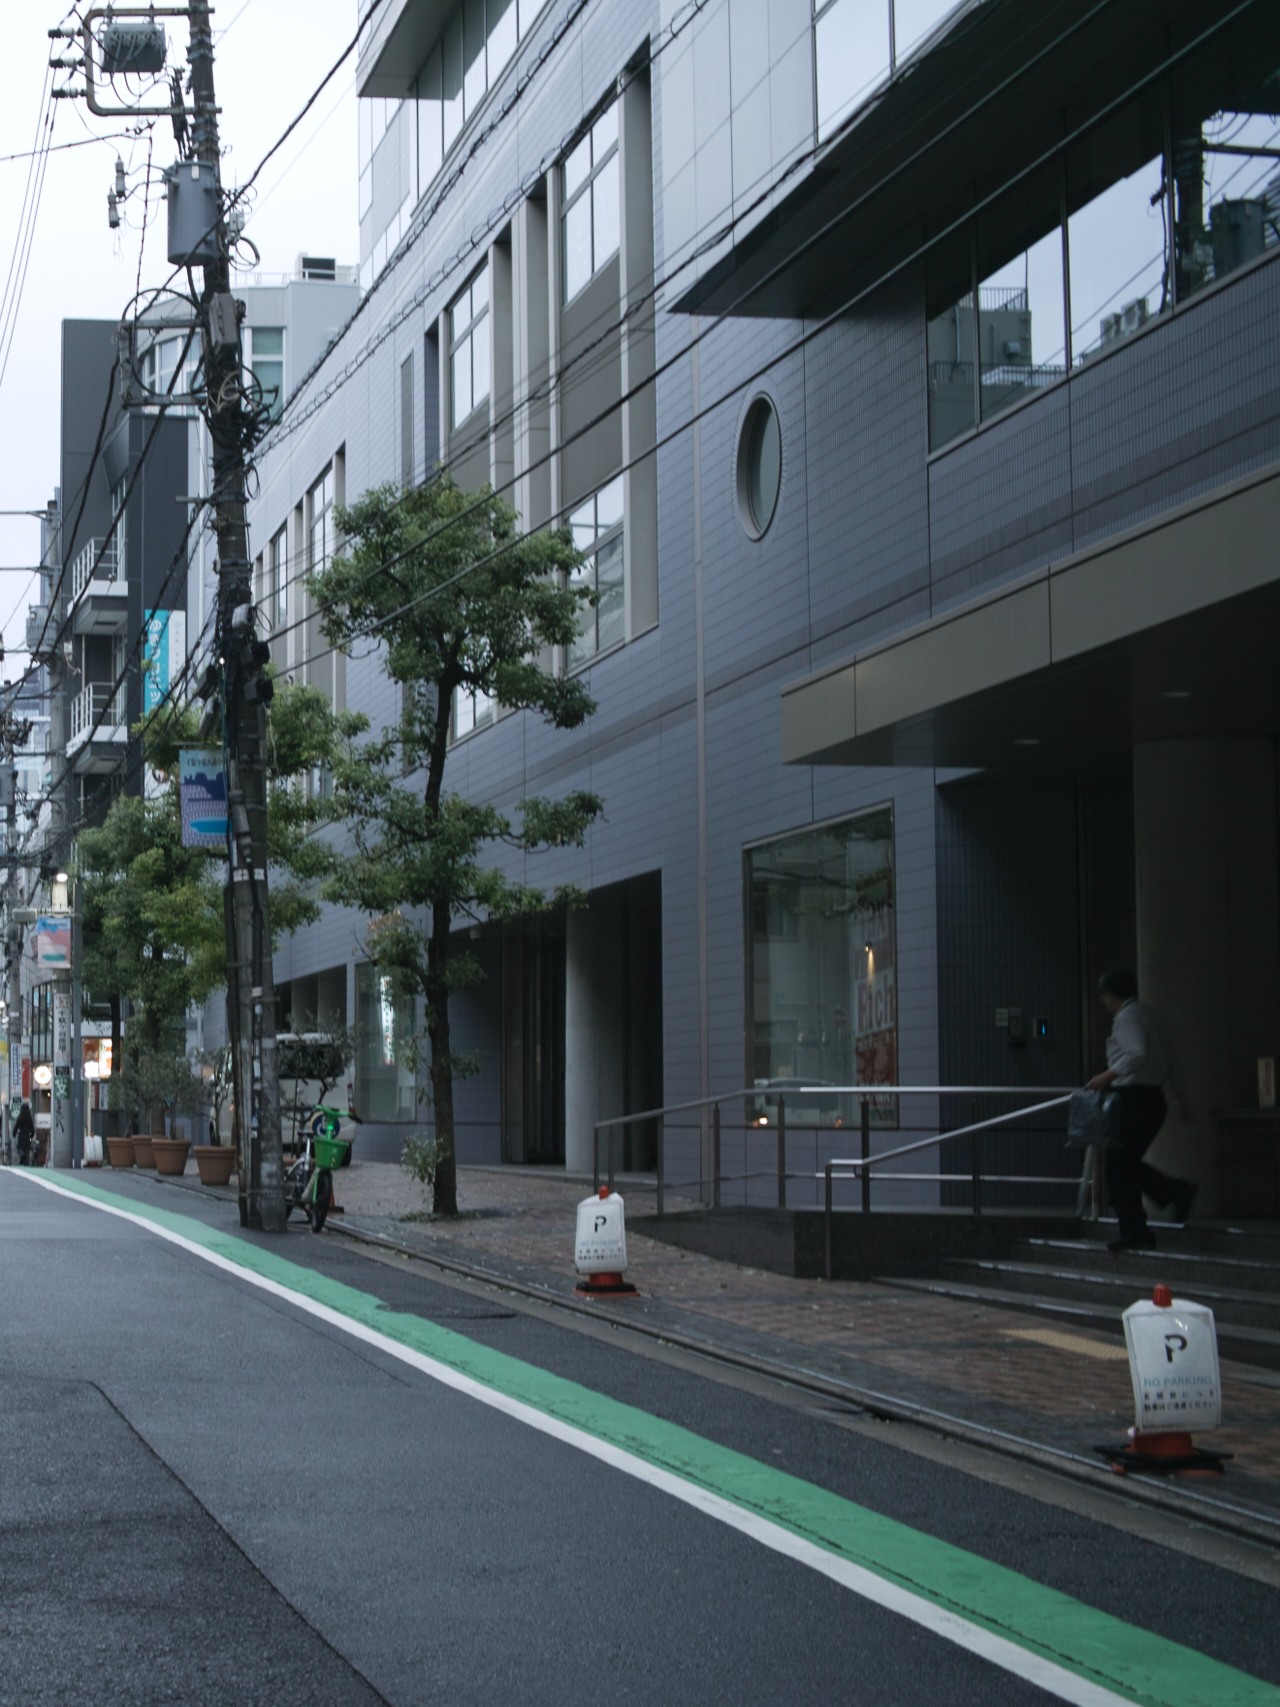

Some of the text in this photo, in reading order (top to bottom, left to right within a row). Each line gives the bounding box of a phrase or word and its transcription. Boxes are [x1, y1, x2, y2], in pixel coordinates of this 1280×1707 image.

[594, 1215, 607, 1233] P
[1164, 1333, 1188, 1363] P
[1143, 1375, 1213, 1388] NO PARKING
